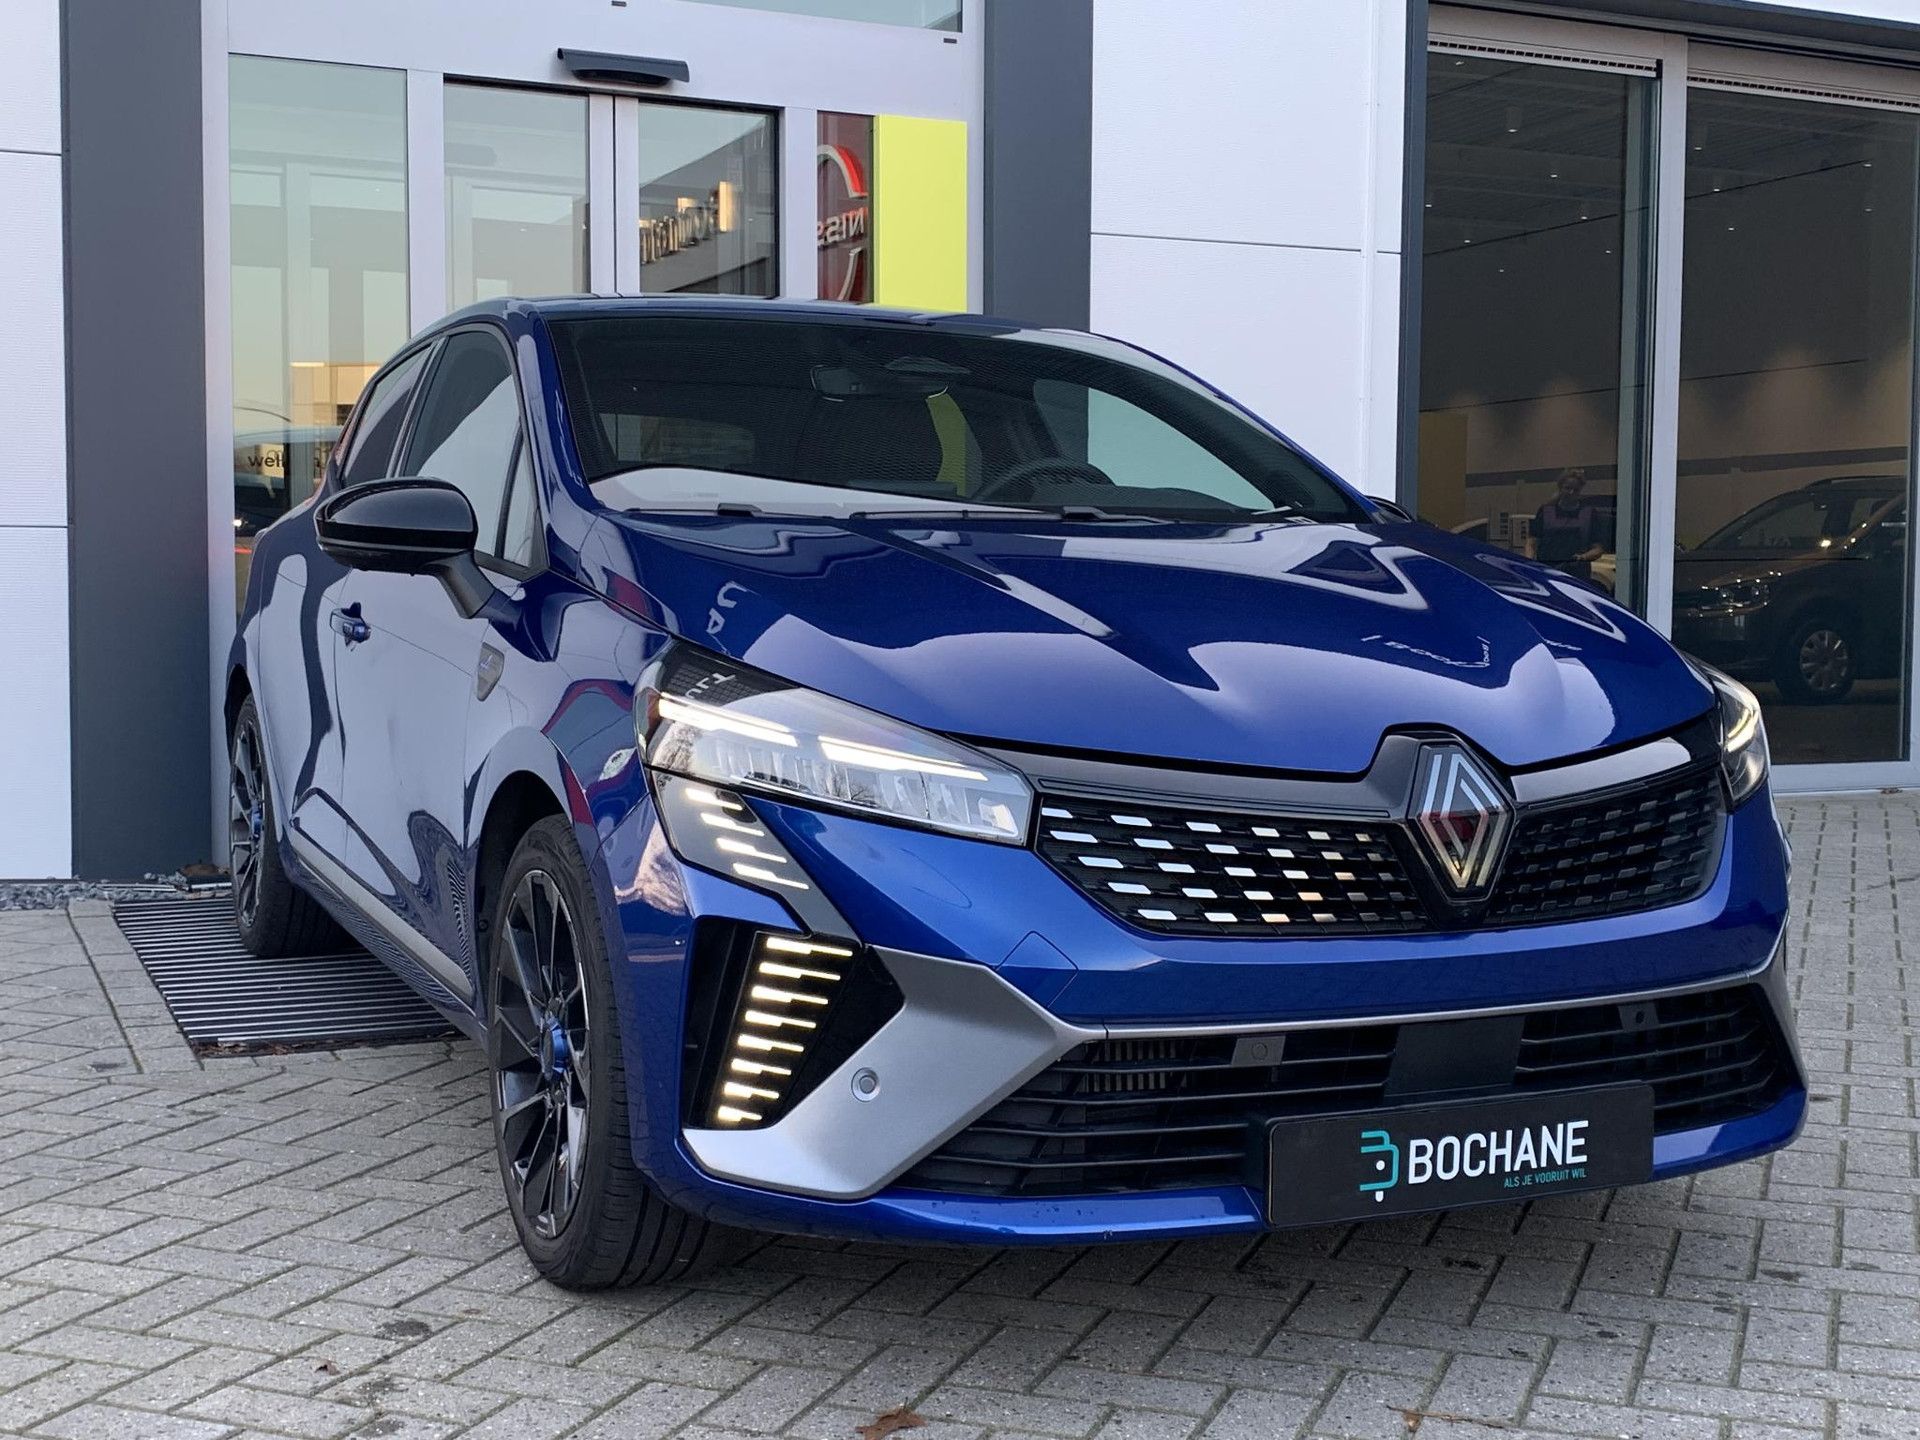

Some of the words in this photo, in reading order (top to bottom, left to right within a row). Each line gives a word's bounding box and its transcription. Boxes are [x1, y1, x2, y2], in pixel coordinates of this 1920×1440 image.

[1407, 1120, 1589, 1185] BOCHANE
[1504, 1176, 1520, 1188] ALS
[1522, 1174, 1533, 1186] JE
[1535, 1169, 1570, 1184] VOORUIT
[1571, 1167, 1588, 1179] WIL
